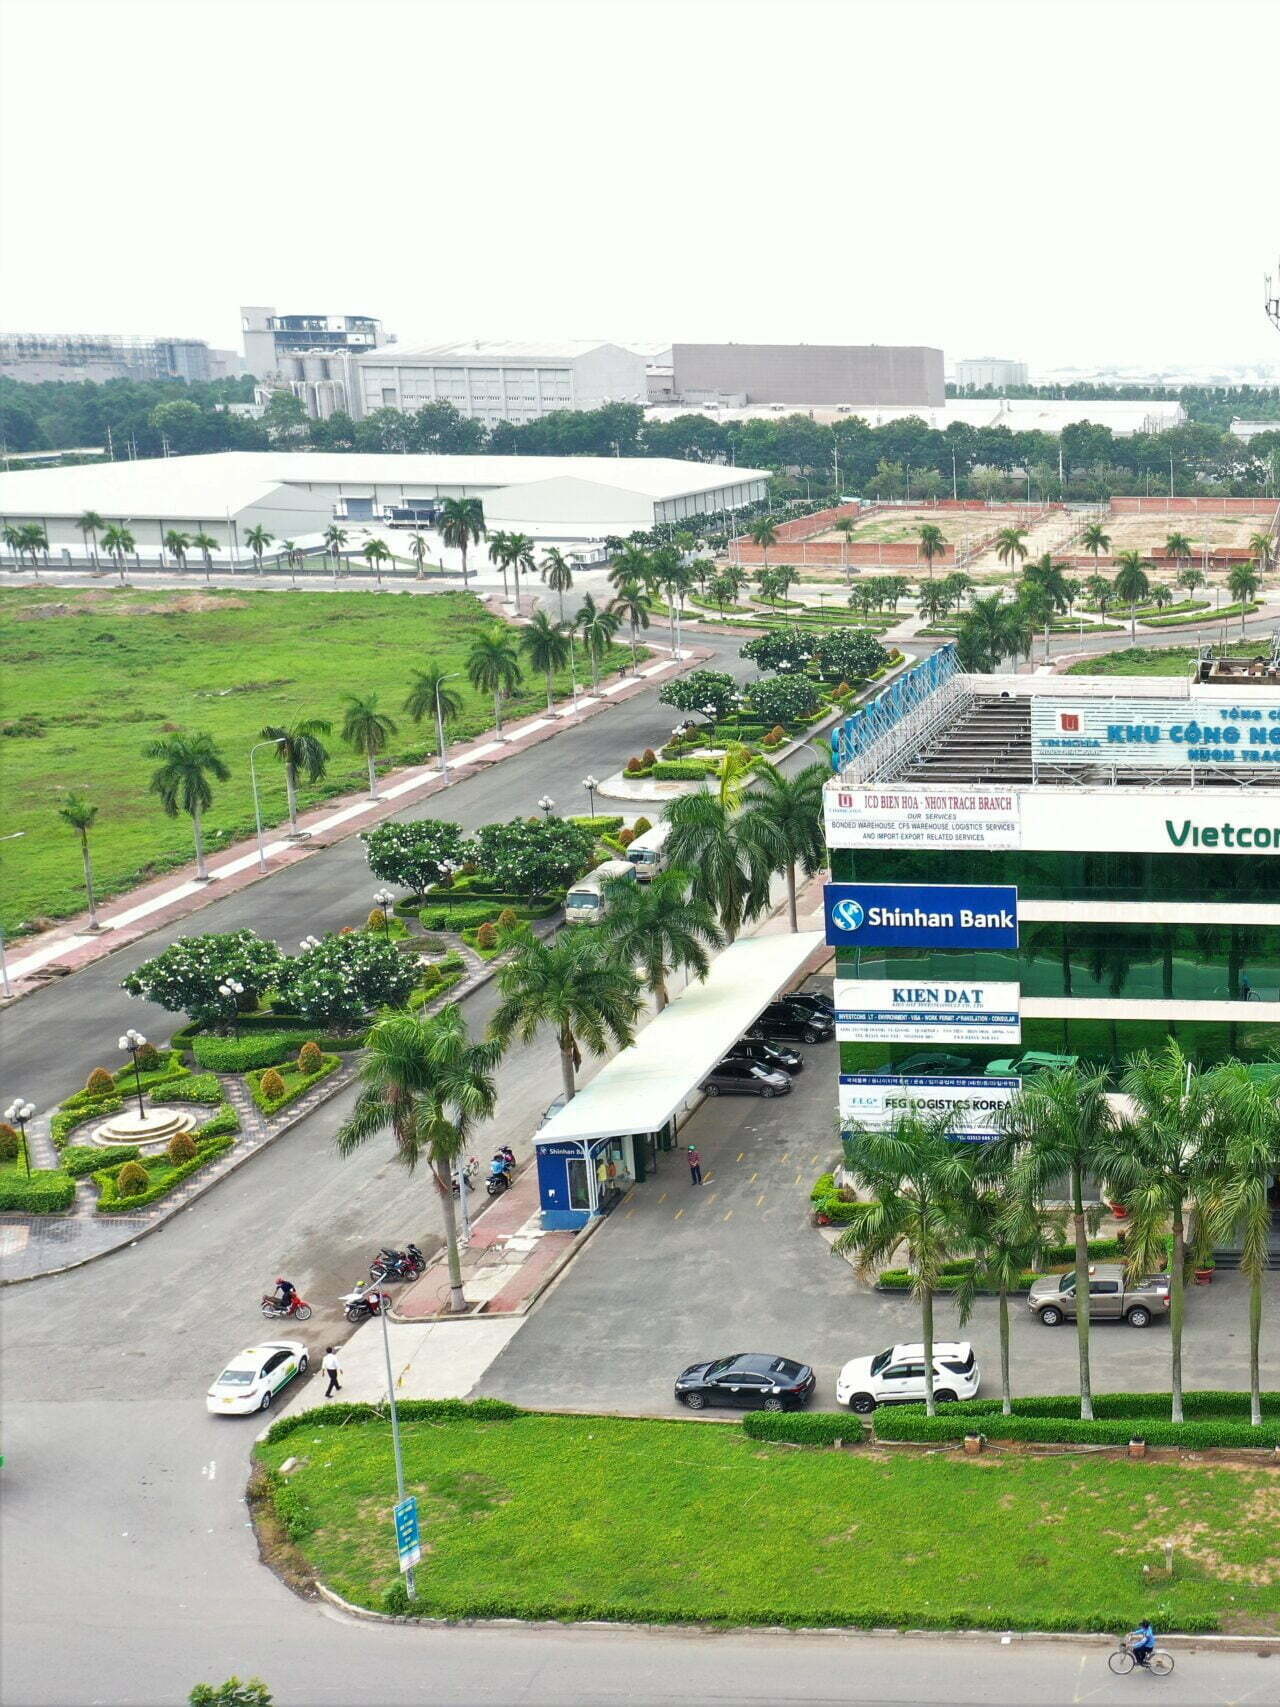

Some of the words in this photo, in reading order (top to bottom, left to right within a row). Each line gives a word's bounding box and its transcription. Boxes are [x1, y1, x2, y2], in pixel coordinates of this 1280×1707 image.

[1107, 725, 1160, 744] KHU
[1169, 720, 1240, 745] CÔNG
[1187, 749, 1235, 762] NHON
[880, 795, 900, 809] BIEN
[902, 795, 919, 809] HOA
[925, 796, 947, 810] NHON
[948, 796, 976, 810] TRACH
[978, 796, 1012, 811] BRANCH
[832, 821, 857, 829] BONDED
[951, 823, 983, 831] LOGISTICS
[985, 823, 1015, 831] SERVICES
[926, 833, 954, 841] RELATED
[868, 907, 954, 928] Shinhan
[960, 909, 1015, 928] Bank
[892, 988, 939, 1003] KIEN
[944, 988, 984, 1004] DAT
[885, 1098, 907, 1109] FEG
[911, 1098, 971, 1110] LOGISTICS
[972, 1100, 1012, 1110] KOREA
